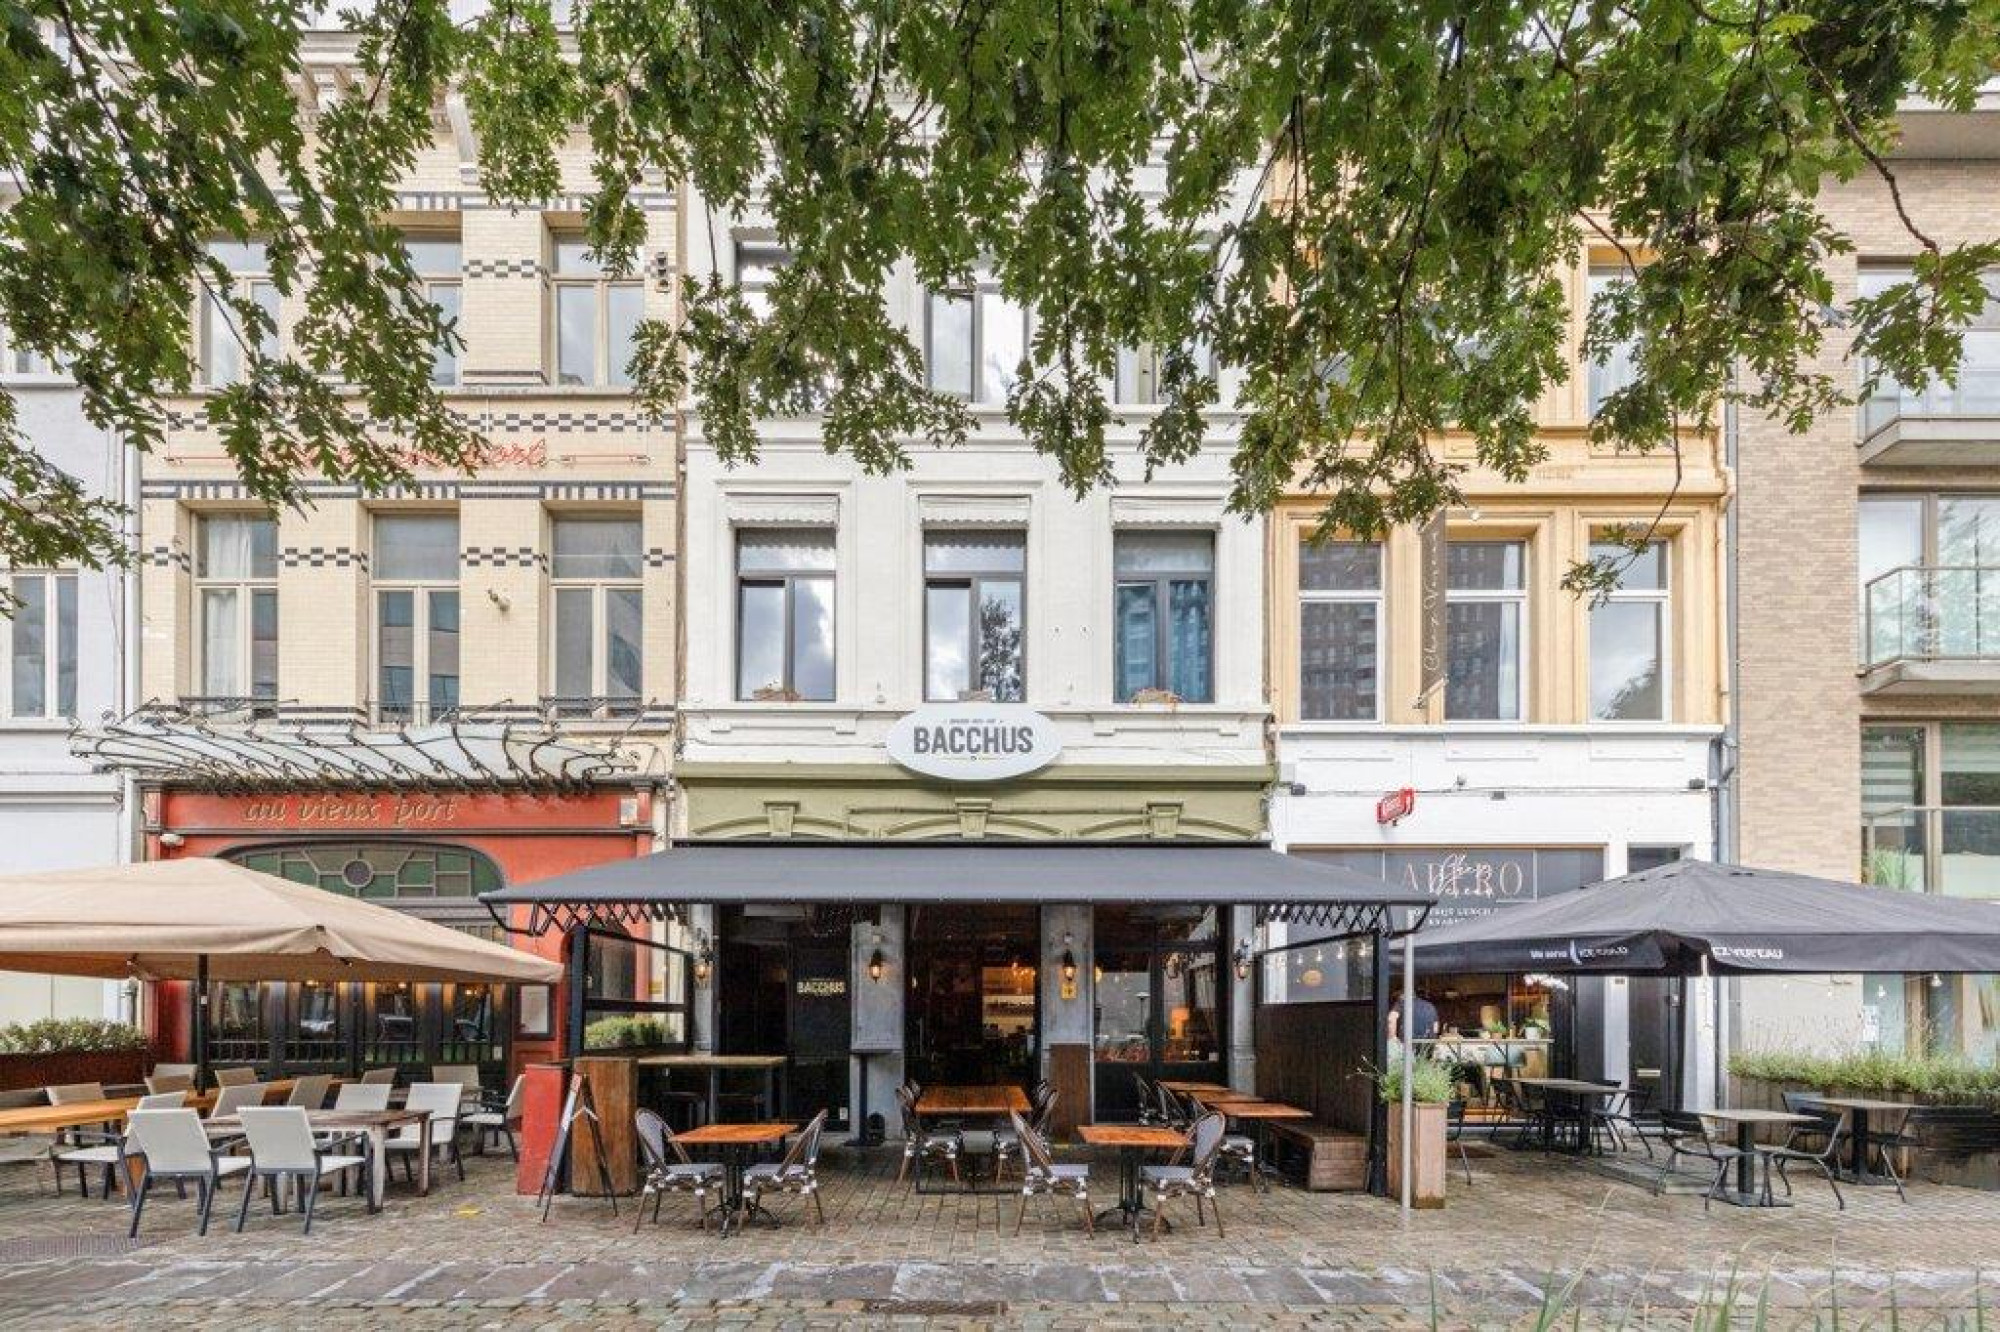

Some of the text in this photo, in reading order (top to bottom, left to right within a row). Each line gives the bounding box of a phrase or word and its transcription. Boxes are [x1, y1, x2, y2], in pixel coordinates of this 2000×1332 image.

[913, 726, 1034, 753] BACCHUS
[243, 797, 459, 826] au vieux port
[796, 981, 846, 993] BACCHUS
